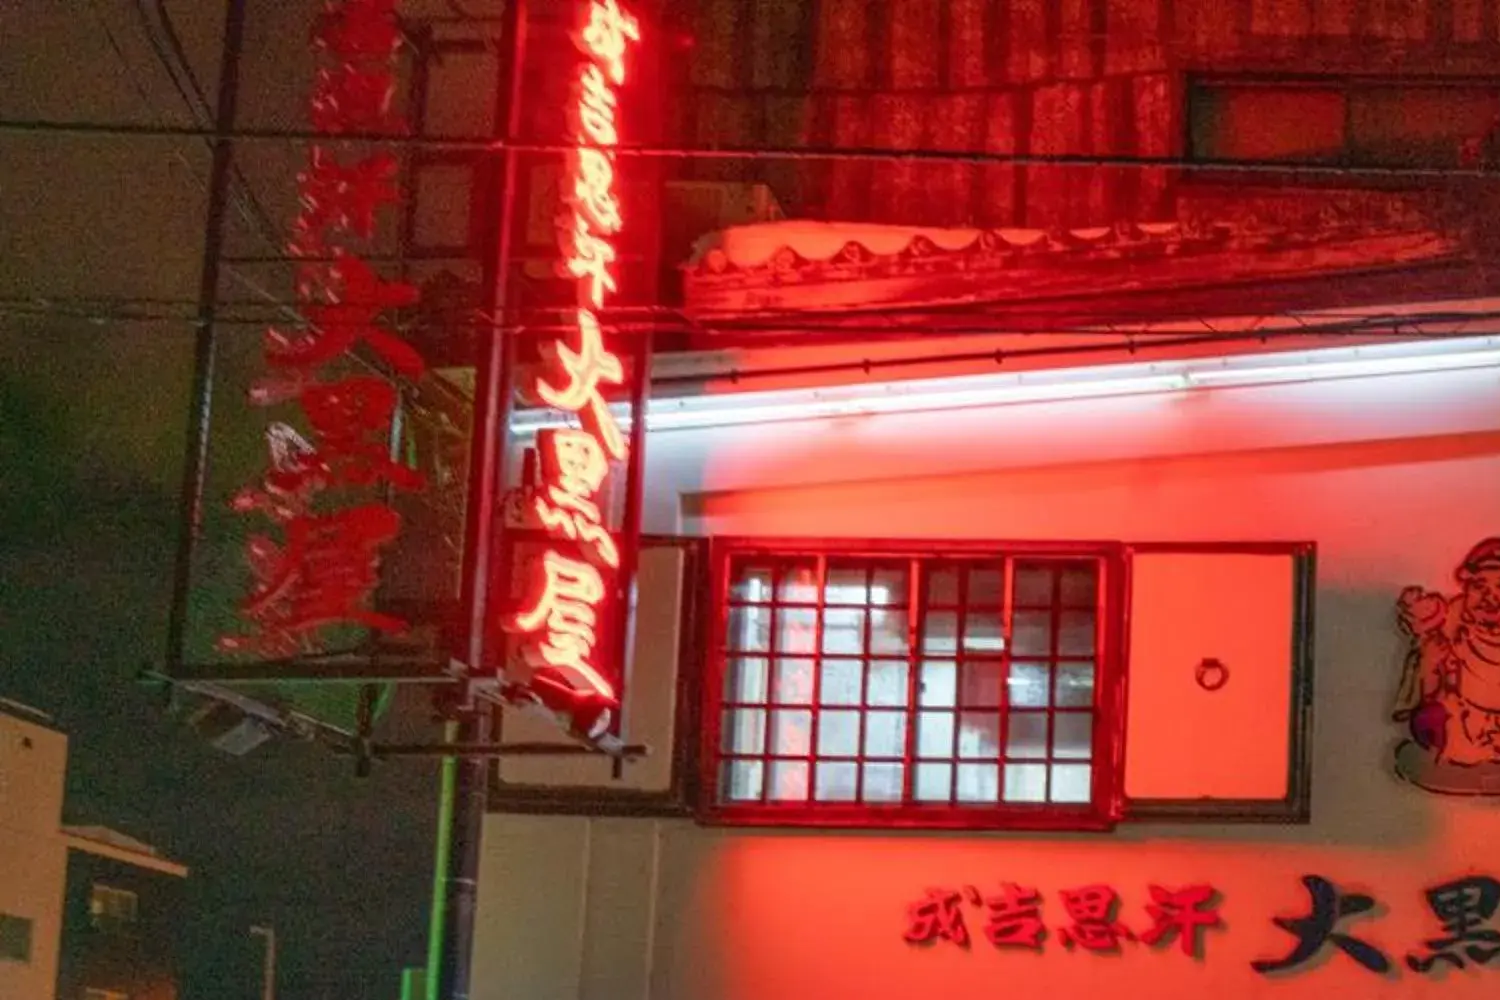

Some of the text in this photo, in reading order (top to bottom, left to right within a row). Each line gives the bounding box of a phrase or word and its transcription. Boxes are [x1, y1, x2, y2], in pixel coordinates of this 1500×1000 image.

[215, 255, 428, 658] 大黒屋
[516, 310, 628, 700] 大黒屋
